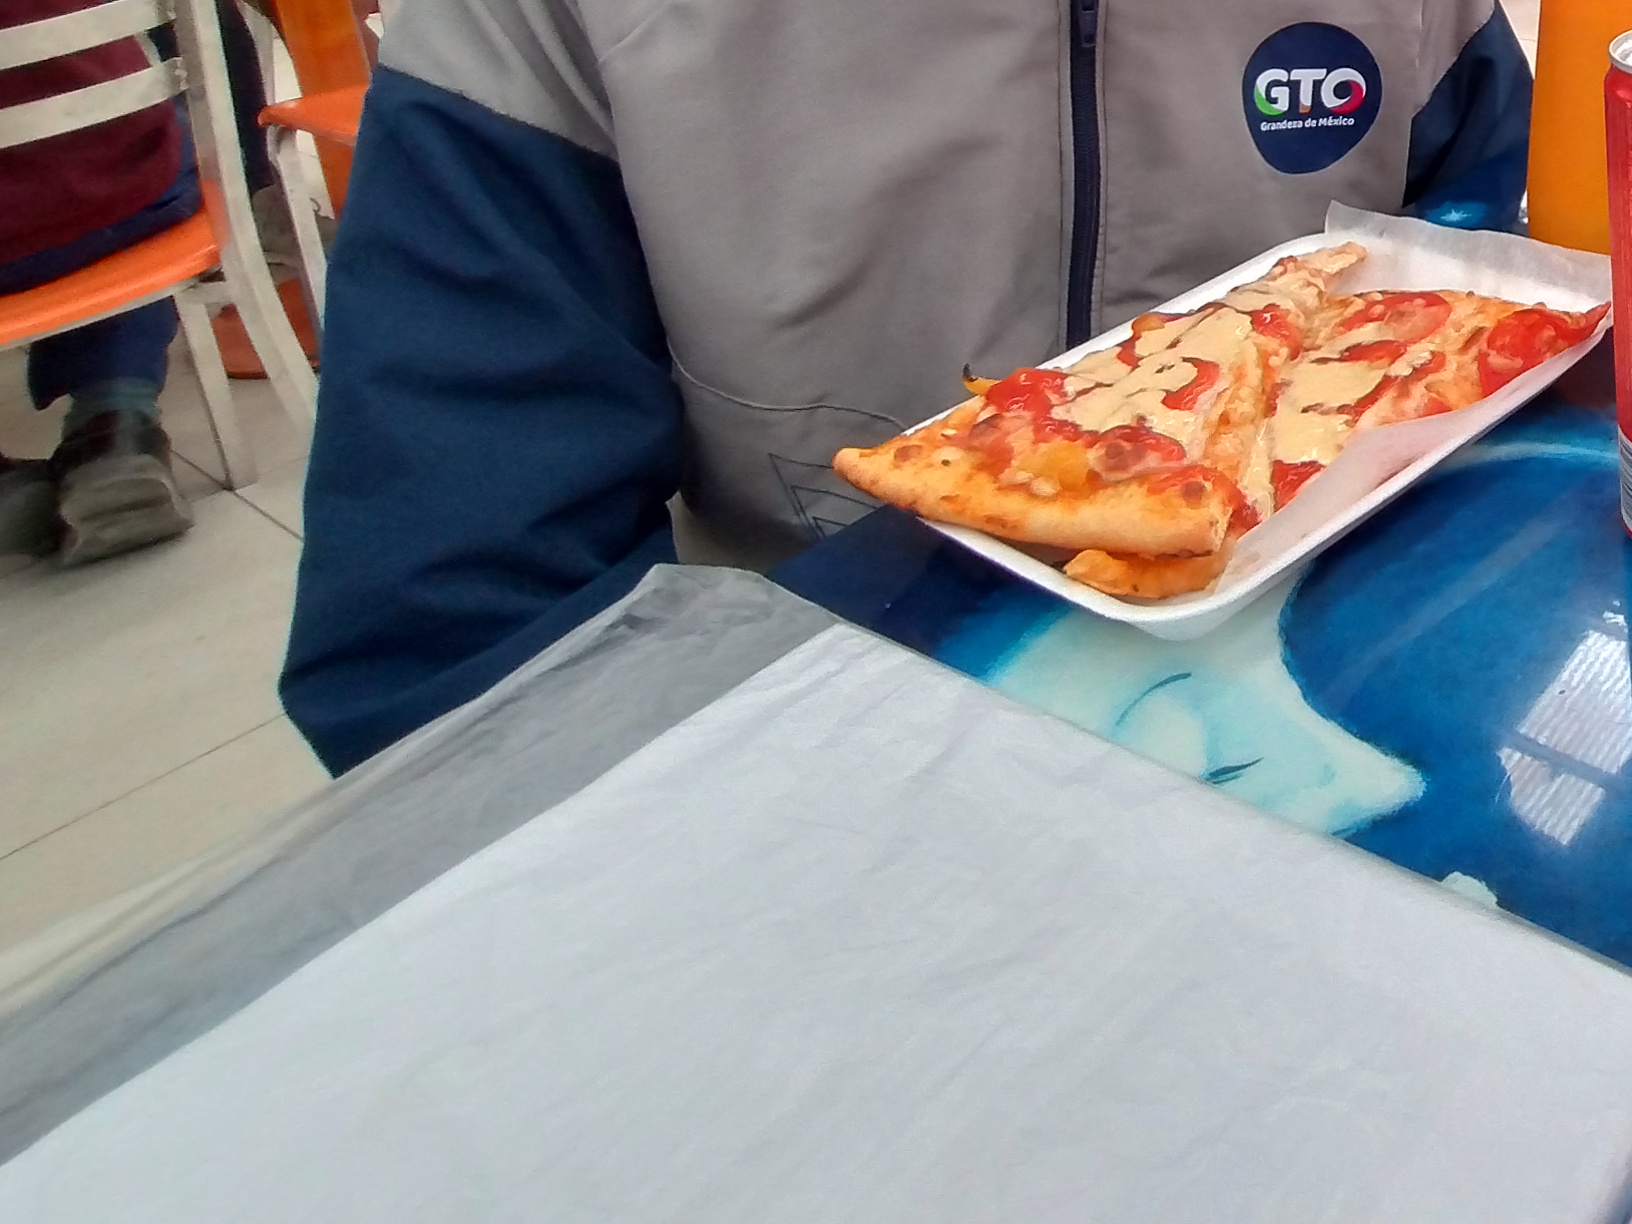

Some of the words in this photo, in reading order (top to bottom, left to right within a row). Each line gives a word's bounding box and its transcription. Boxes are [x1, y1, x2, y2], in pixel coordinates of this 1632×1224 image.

[1254, 68, 1366, 115] GTO
[1260, 120, 1302, 131] Grandeza
[1305, 118, 1316, 128] de
[1318, 115, 1355, 127] México
